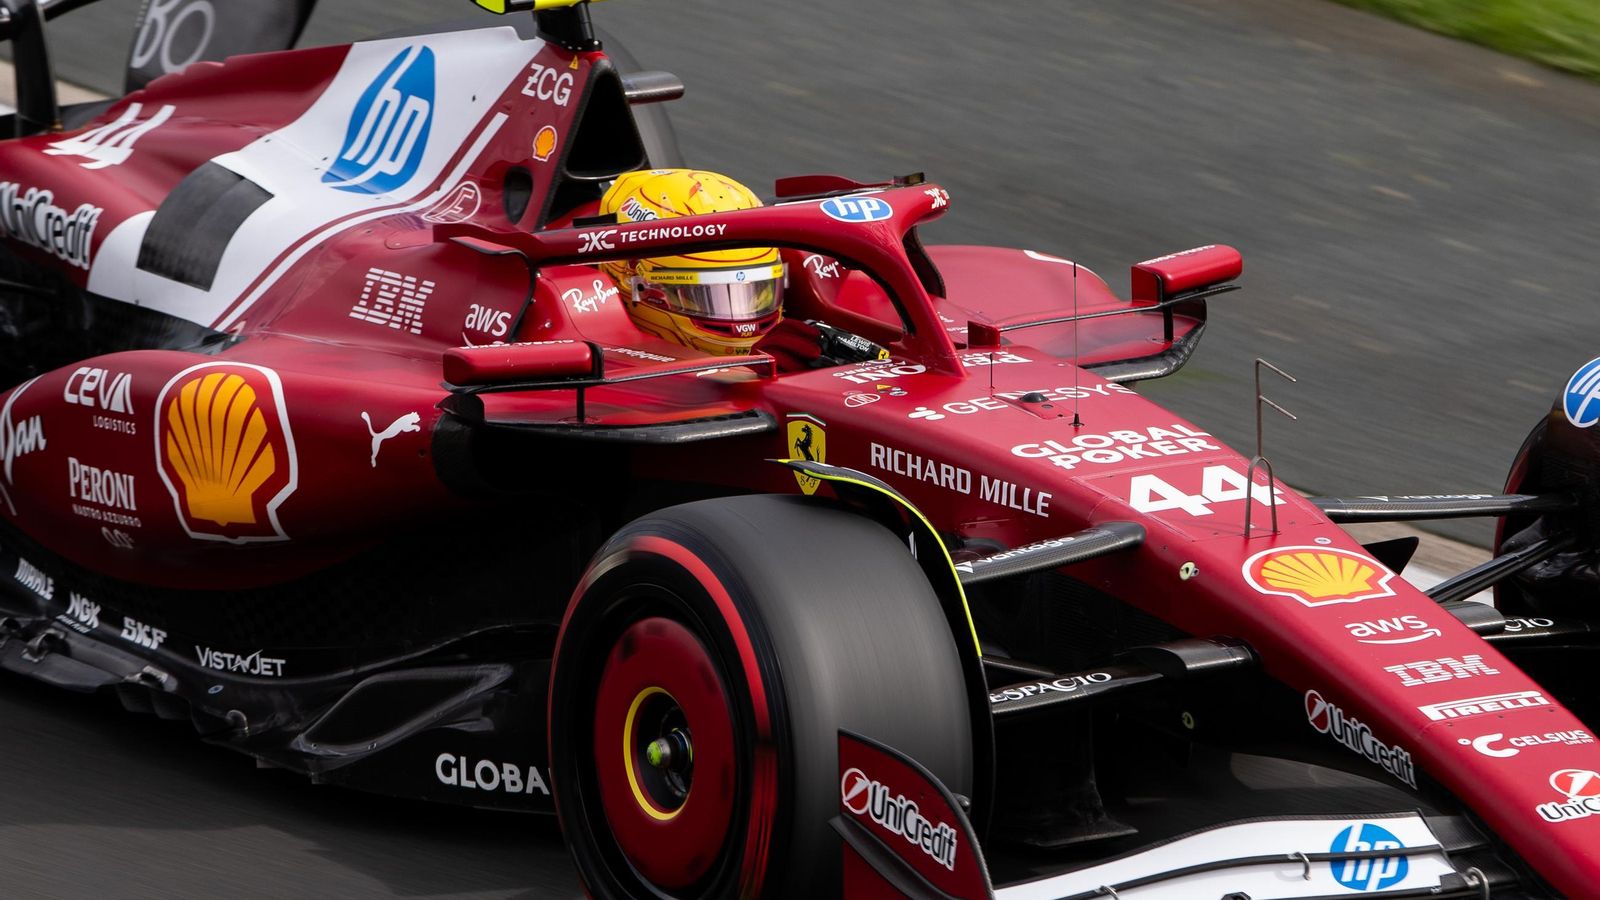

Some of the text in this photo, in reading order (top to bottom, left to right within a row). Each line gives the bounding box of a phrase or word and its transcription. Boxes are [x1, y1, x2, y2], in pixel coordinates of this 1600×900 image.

[322, 44, 435, 194] hp
[627, 202, 658, 221] UniC
[830, 196, 886, 221] hp
[620, 223, 727, 243] TECHNOLOGY
[349, 266, 436, 335] IBM
[464, 303, 512, 337] aws
[736, 323, 757, 333] VGW
[92, 414, 136, 435] LOGISTICS
[1011, 424, 1211, 458] GLOBAL
[1047, 437, 1221, 470] POKER
[67, 456, 137, 511] PERONI
[870, 442, 1052, 518] RICHARD MILLE
[1129, 464, 1287, 517] 44
[977, 536, 1075, 563] vantage
[65, 590, 102, 629] NGK
[120, 616, 167, 650] SKF
[1344, 615, 1429, 638] aws
[1384, 654, 1501, 687] IBM
[1417, 690, 1552, 721] PIRELLI
[1327, 702, 1418, 790] UniCredit
[1509, 730, 1594, 747] CELSIUS
[435, 752, 553, 796] GLOBA
[868, 780, 958, 871] UniCredit
[1536, 797, 1600, 823] UniC
